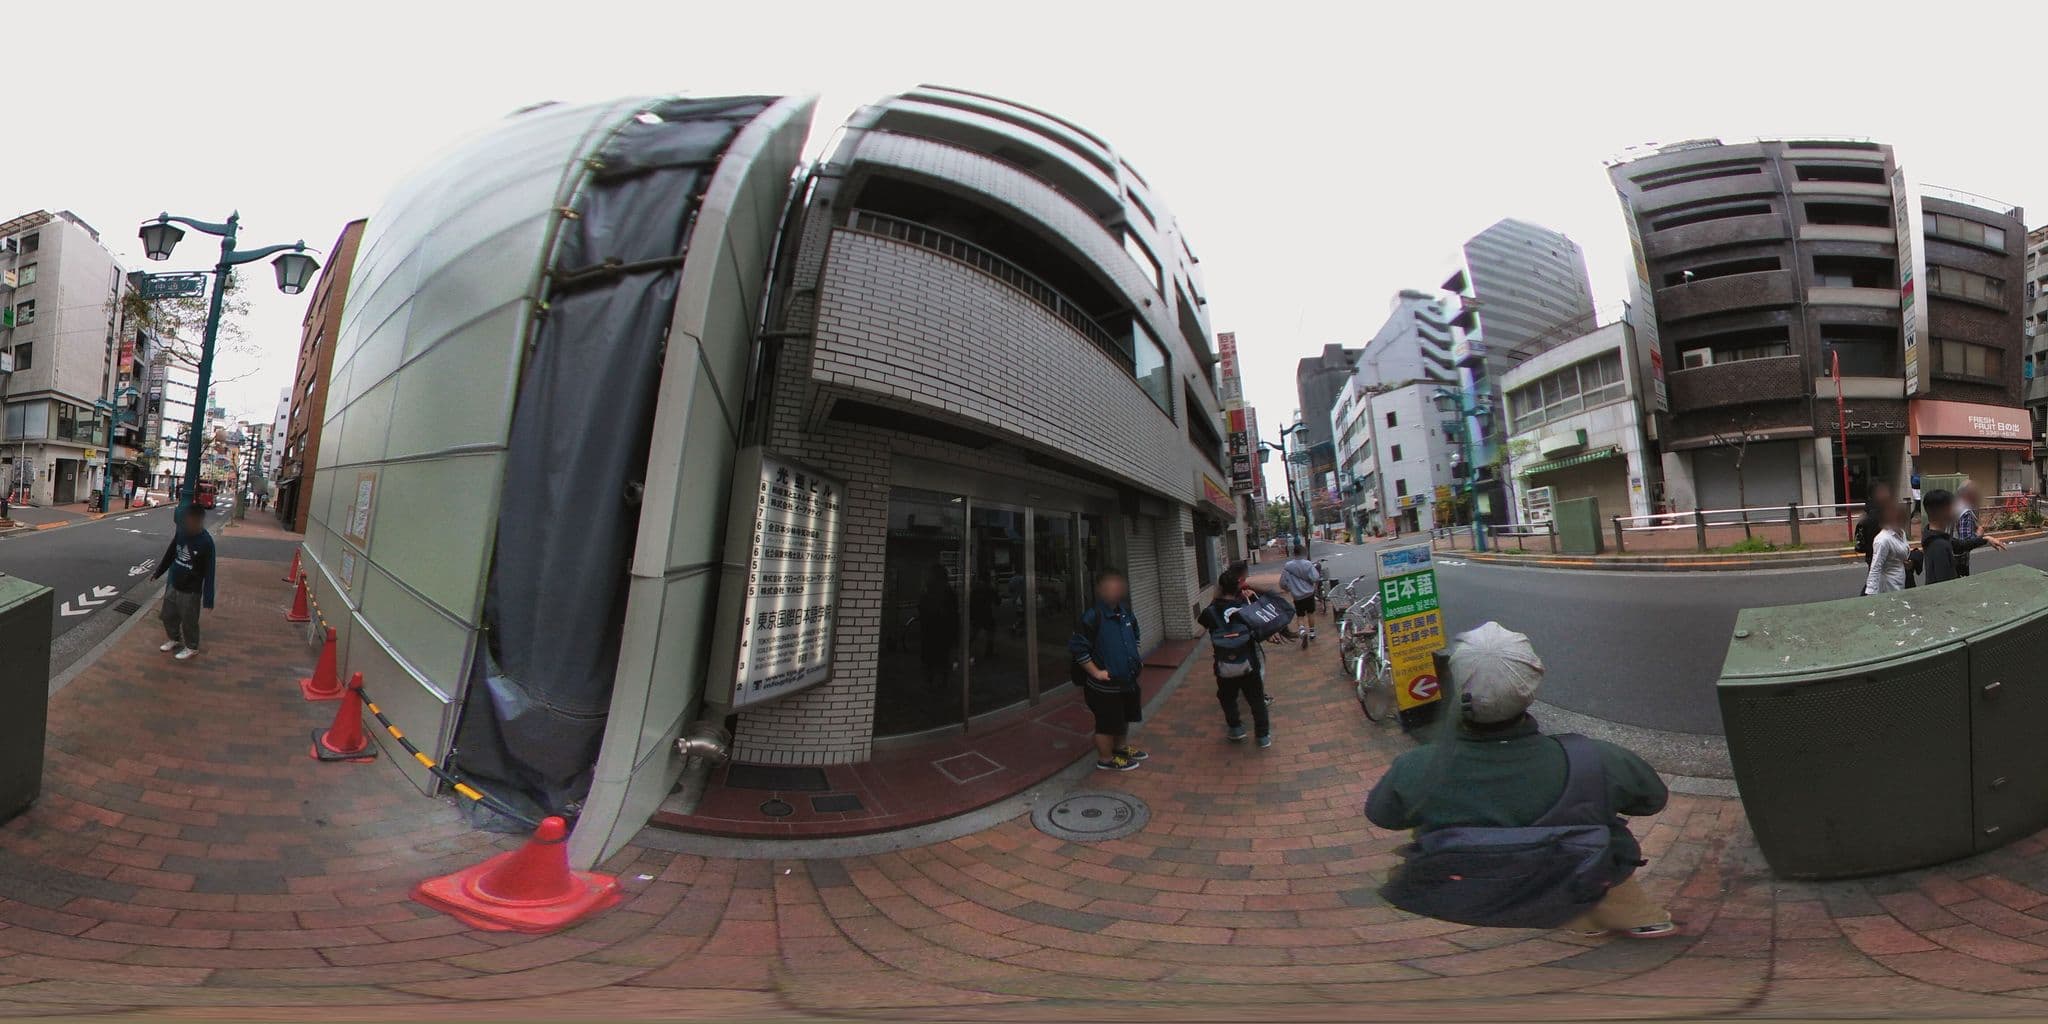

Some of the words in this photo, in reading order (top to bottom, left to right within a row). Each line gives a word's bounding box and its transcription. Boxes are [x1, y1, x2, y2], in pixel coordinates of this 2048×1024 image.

[1220, 335, 1233, 377] 日本語学院
[1968, 415, 1995, 423] FRESH
[1974, 422, 1996, 430] FRUIT
[1997, 422, 2020, 432] 日の出
[761, 482, 767, 491] 8
[760, 495, 766, 504] 8
[771, 498, 793, 510] 株式会社
[759, 508, 764, 517] 7
[757, 521, 762, 530] 6
[755, 534, 760, 543] 6
[753, 547, 759, 556] 6
[752, 560, 757, 570] 5
[750, 574, 756, 583] 5
[763, 574, 782, 582] 株式会社
[749, 586, 755, 595] 5
[760, 586, 784, 595] 株式会社
[1383, 573, 1433, 603] 日本語
[1255, 603, 1280, 623] GAP
[1386, 604, 1414, 618] Japanese
[745, 617, 751, 625] 5
[757, 604, 832, 631] 東京国際日本語学院
[1390, 614, 1437, 635] 東京国際
[1391, 626, 1439, 647] 日本語学院
